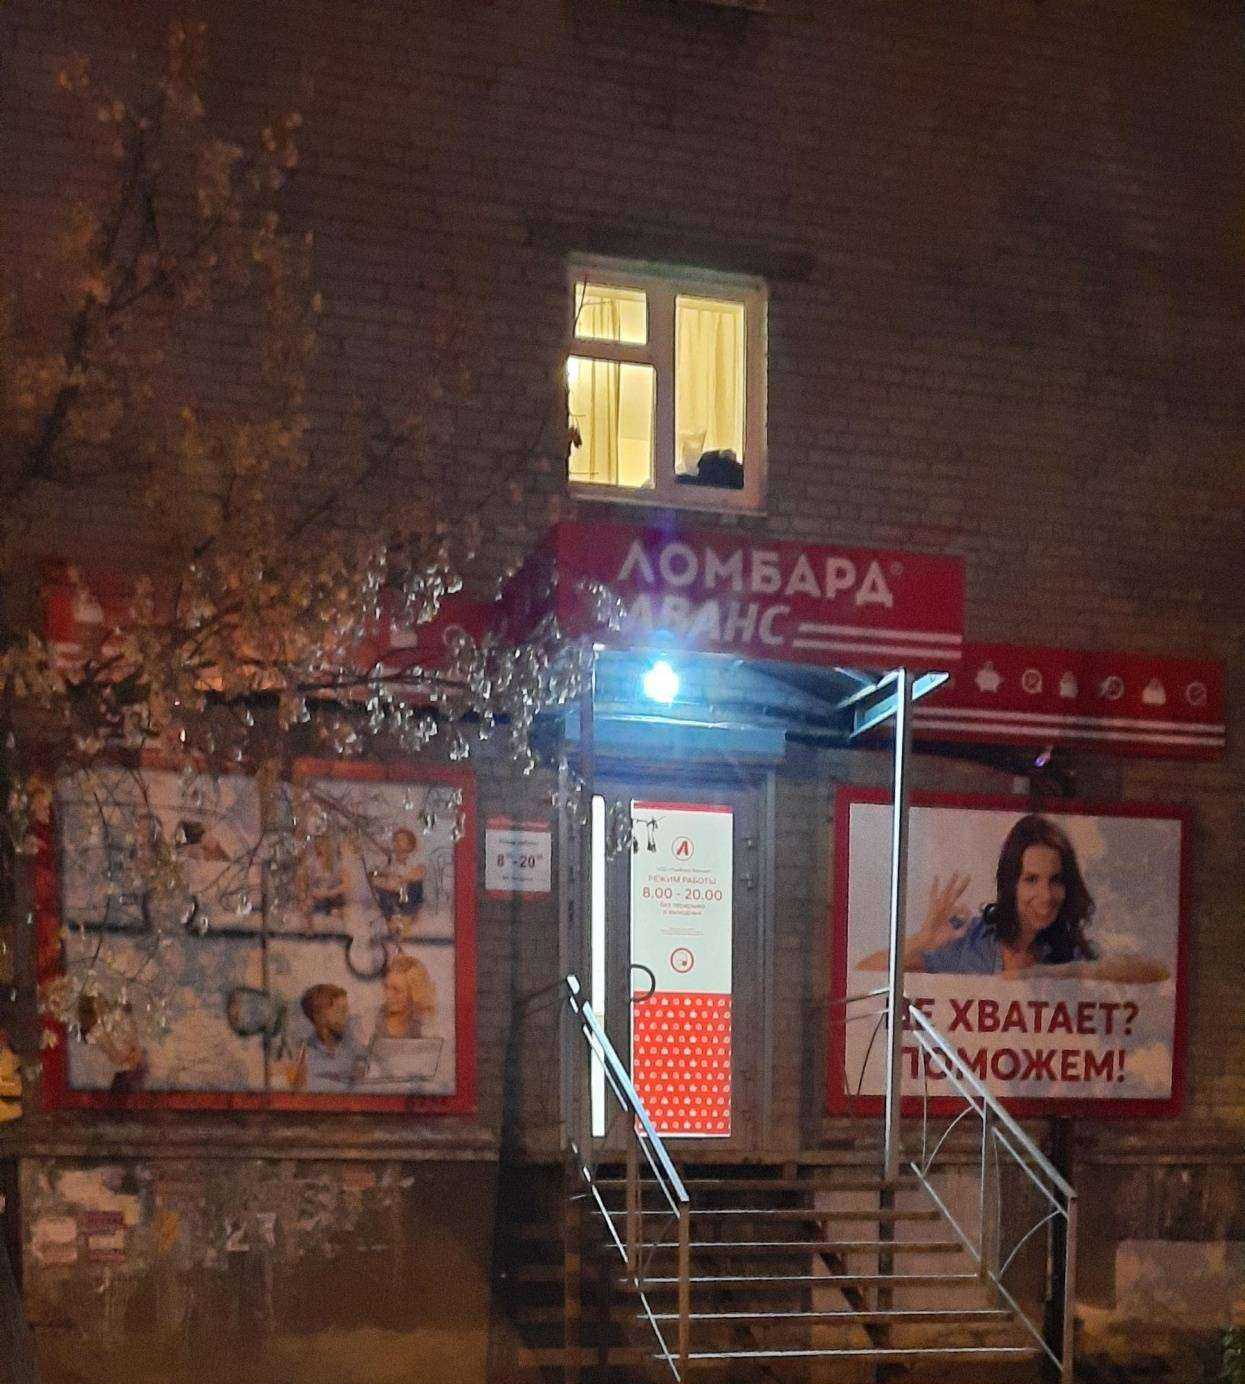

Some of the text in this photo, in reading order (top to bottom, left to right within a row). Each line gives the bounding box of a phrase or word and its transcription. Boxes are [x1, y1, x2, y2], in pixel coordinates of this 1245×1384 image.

[617, 539, 893, 608] ЛОМБАРД
[642, 886, 673, 899] 8.00
[685, 888, 723, 901] 20.00
[947, 999, 1140, 1036] ХВАТАЕТ?
